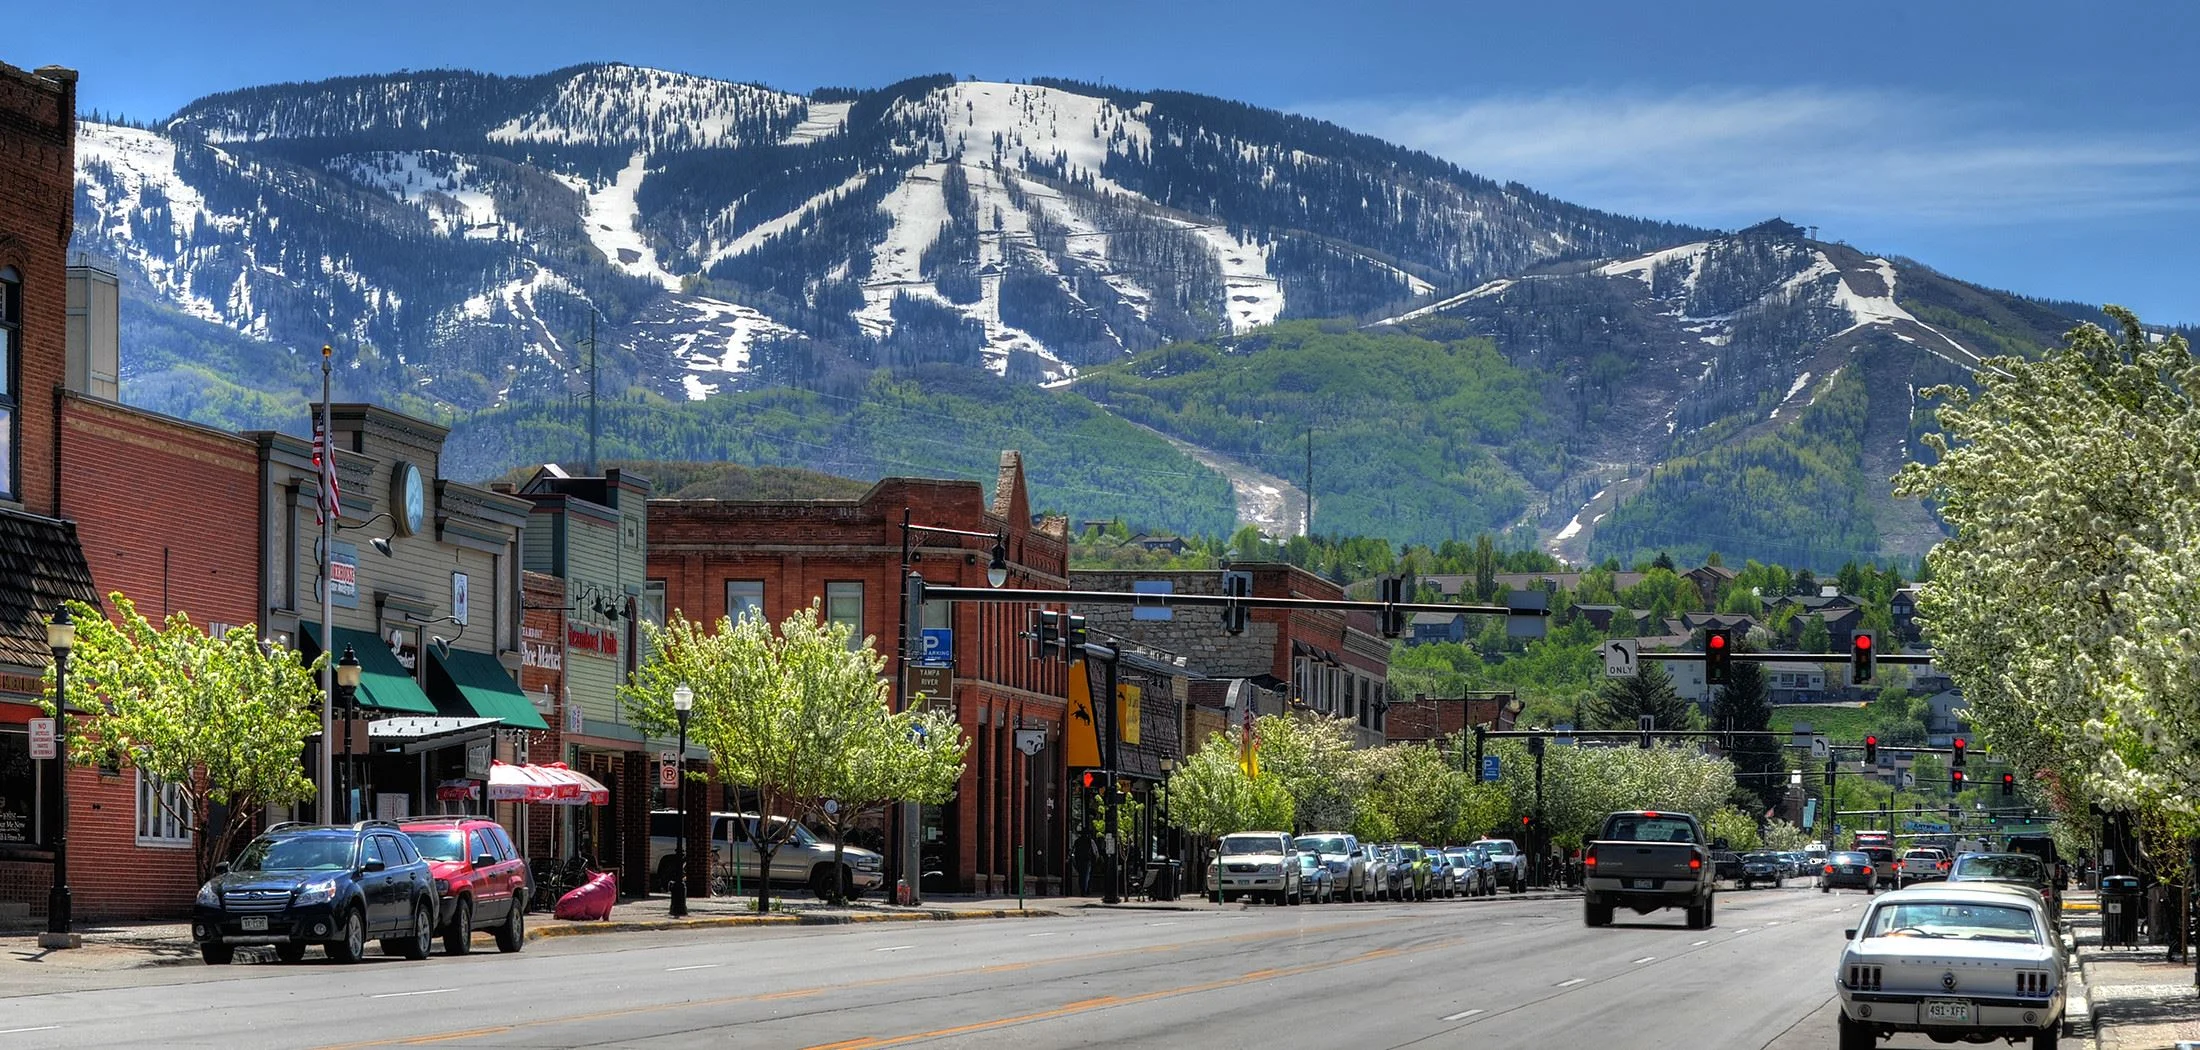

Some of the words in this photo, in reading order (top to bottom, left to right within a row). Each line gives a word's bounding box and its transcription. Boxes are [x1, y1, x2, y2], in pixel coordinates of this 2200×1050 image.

[537, 644, 561, 670] Market
[920, 669, 940, 677] YAMPA
[1610, 666, 1633, 675] ONLY
[921, 678, 939, 686] RIVER
[1929, 1005, 1966, 1017] 491-XFF
